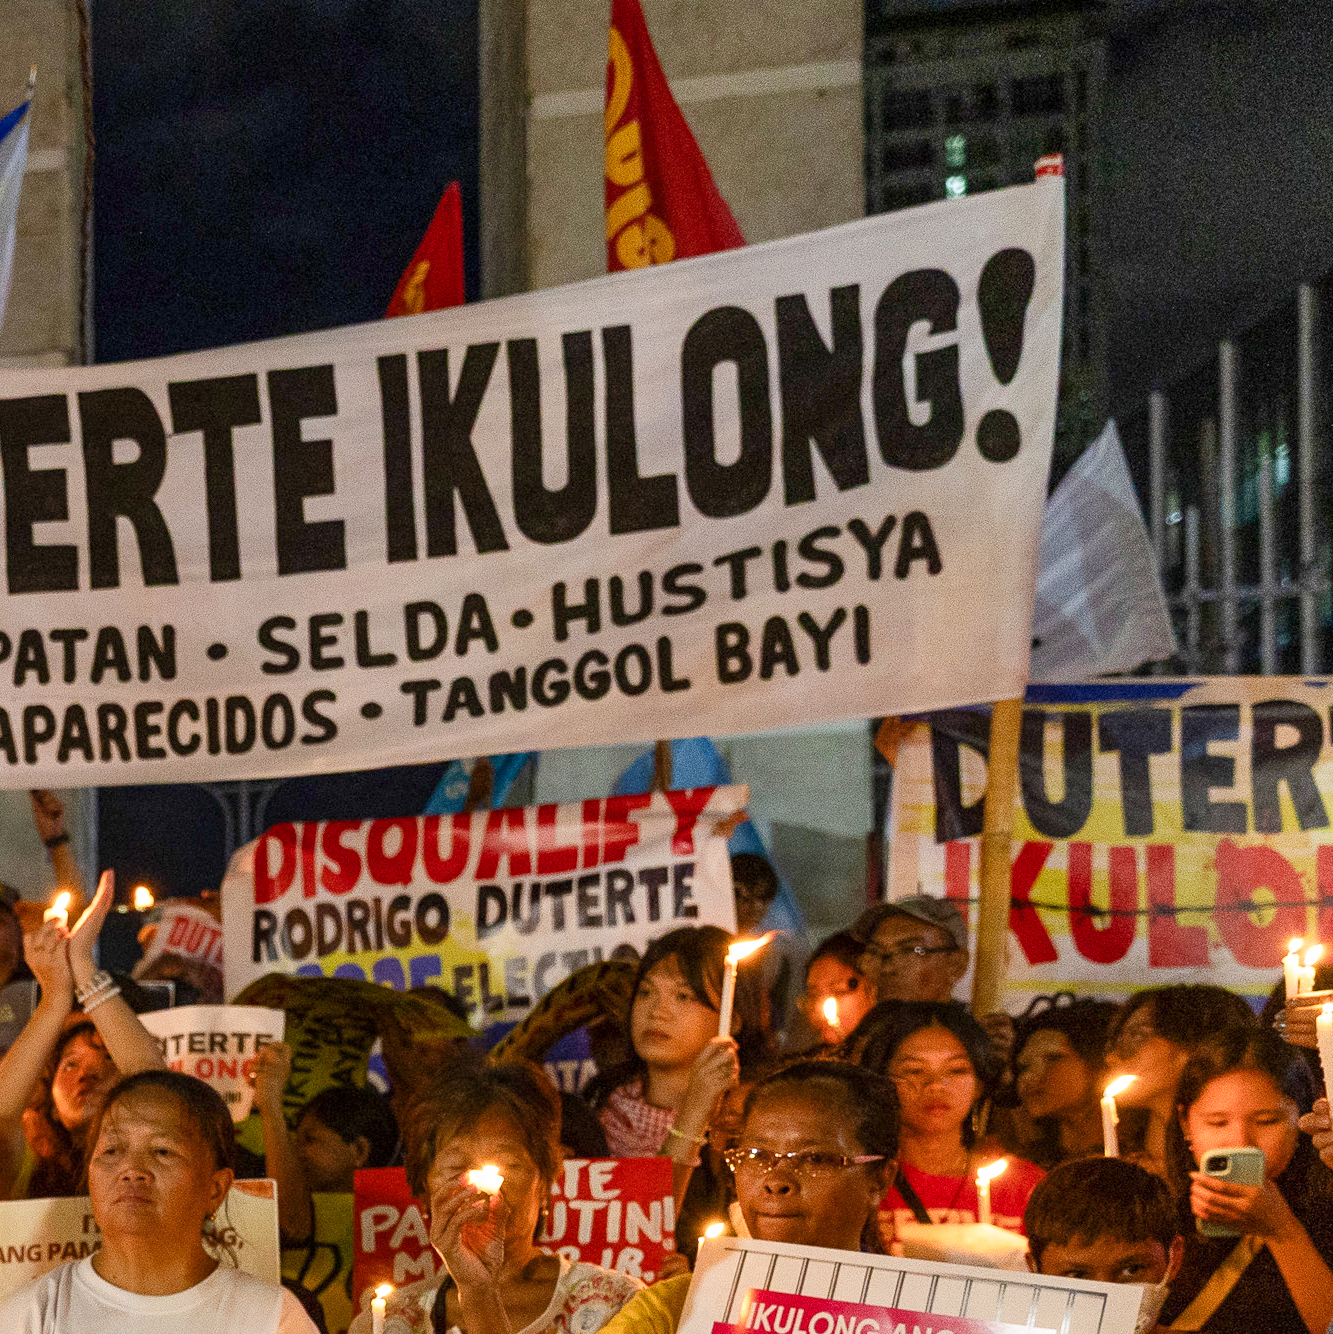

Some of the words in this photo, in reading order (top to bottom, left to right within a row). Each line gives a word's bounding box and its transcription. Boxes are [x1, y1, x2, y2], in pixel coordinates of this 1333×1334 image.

[376, 246, 1035, 564] IKULONG!
[257, 592, 500, 675] SELDA
[551, 510, 943, 642] HUSTISYA
[400, 635, 691, 726] TANGGOL
[714, 604, 872, 686] BAYI
[931, 700, 1333, 844] DUTER
[252, 785, 719, 906] DISQUALIFY
[251, 892, 452, 965] RODRIGO
[476, 863, 700, 942] DUTERTE
